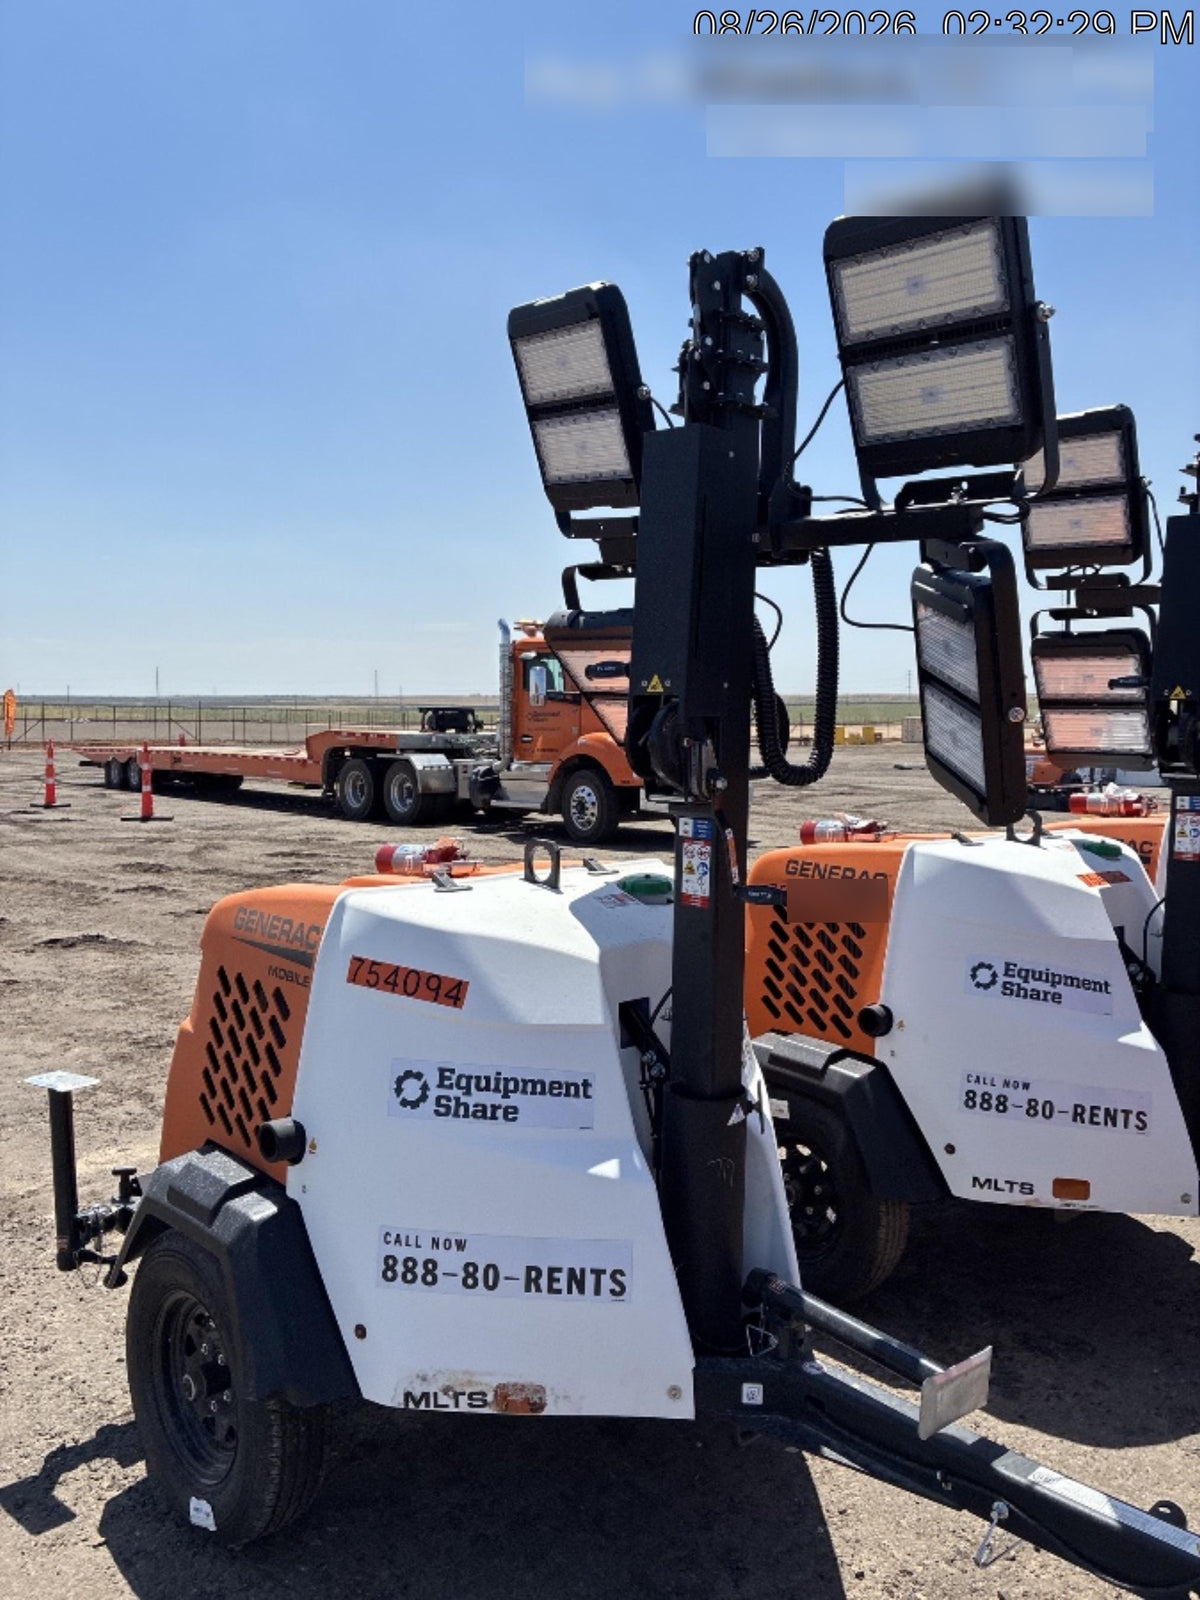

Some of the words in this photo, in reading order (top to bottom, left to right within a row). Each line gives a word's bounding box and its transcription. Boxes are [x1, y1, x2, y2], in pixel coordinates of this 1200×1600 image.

[234, 906, 321, 950] GENERAC
[268, 965, 311, 988] MOBILE
[352, 956, 463, 1008] 754094
[1003, 961, 1112, 995] Equipment
[1001, 981, 1063, 1005] Share
[435, 1066, 593, 1099] Equipment
[966, 1073, 997, 1087] CALL
[1003, 1077, 1031, 1091] NOW
[433, 1094, 520, 1123] Share
[963, 1089, 1148, 1132] 888-80-RENTS
[971, 1176, 1035, 1196] MLTS
[383, 1231, 422, 1249] CALL
[431, 1236, 467, 1252] NOW
[381, 1254, 627, 1297] 888-80-RENTS
[403, 1391, 489, 1409] MLTS
